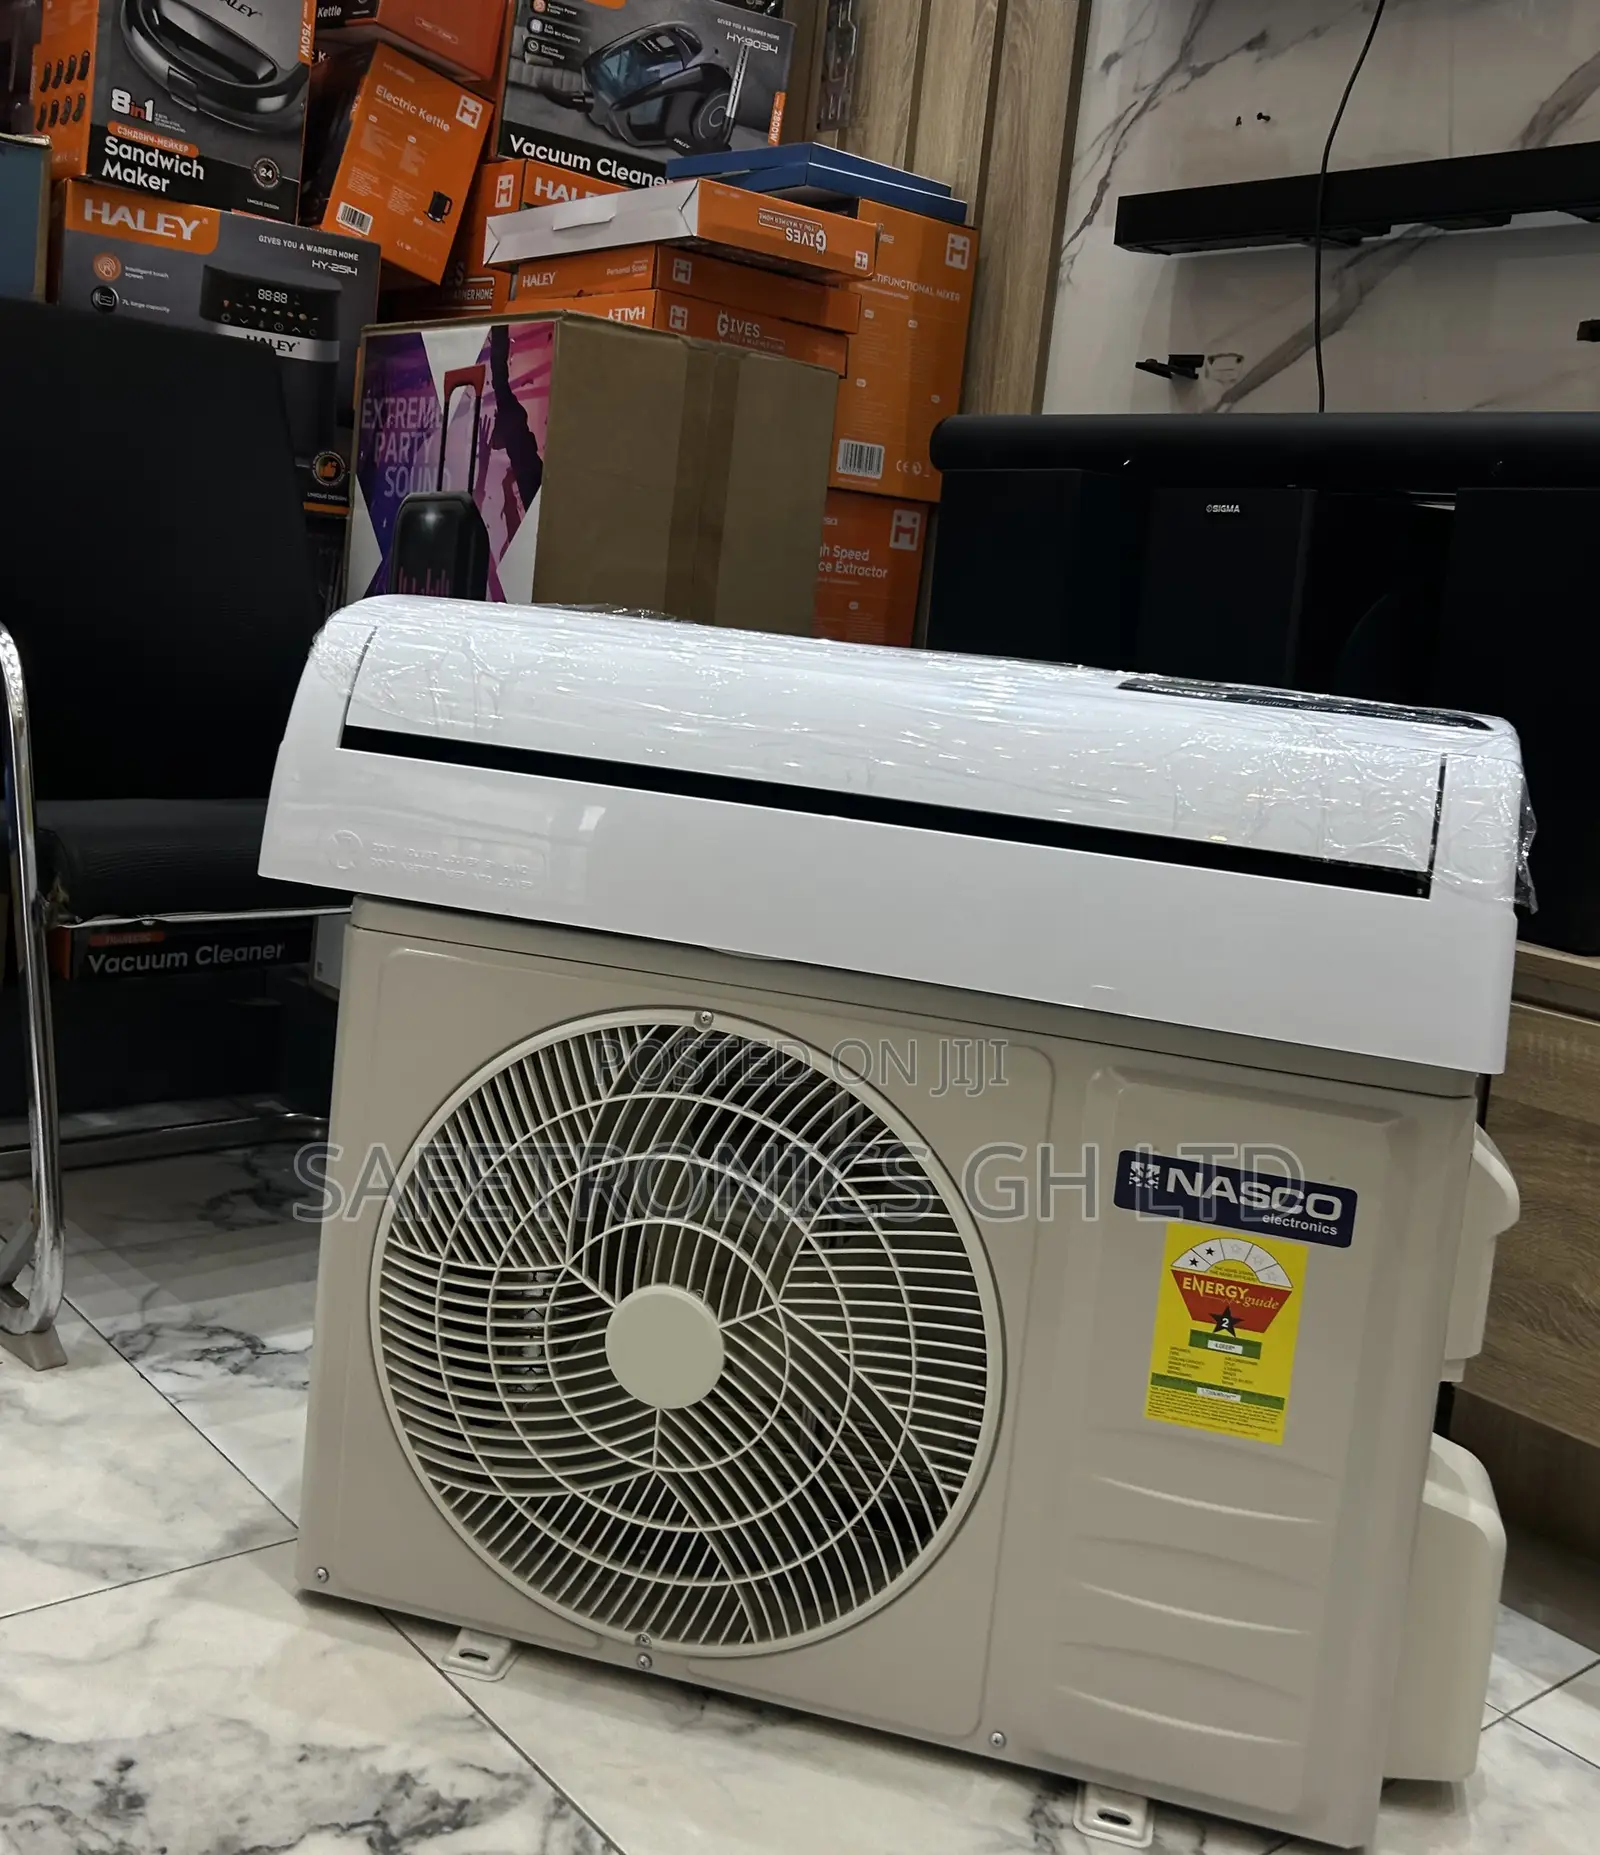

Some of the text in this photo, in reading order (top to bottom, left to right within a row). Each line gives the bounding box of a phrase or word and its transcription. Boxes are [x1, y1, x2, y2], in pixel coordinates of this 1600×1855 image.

[317, 5, 342, 18] Kettle
[300, 20, 312, 58] 750W
[726, 32, 779, 54] HY-9034
[375, 84, 417, 115] Electric
[418, 107, 451, 132] Kettle
[770, 110, 782, 142] 2800W
[104, 136, 205, 180] Sandwich
[510, 133, 590, 174] Vacuum
[102, 159, 170, 192] Maker
[259, 168, 272, 178] 24
[84, 198, 200, 240] HALEY
[759, 212, 774, 222] HOME
[774, 216, 798, 228] WARMER
[258, 234, 282, 246] GIVES
[282, 239, 298, 249] YOU
[306, 244, 338, 256] WARMER
[338, 250, 360, 262] HOME
[785, 227, 826, 254] GIVES
[522, 272, 556, 288] HALEY
[476, 288, 494, 300] HOME
[936, 288, 962, 304] MIXER
[146, 304, 170, 314] capacity
[608, 306, 646, 322] HALEY
[717, 309, 760, 338] GIVES
[374, 431, 434, 465] PARTY
[833, 544, 870, 562] Speed
[835, 560, 888, 579] Extractor
[88, 942, 285, 974] Vacuum Cleaner
[1166, 1167, 1342, 1221] NASCO
[1262, 1213, 1338, 1236] electronics
[1182, 1274, 1280, 1310] ENERGY guide
[1222, 1317, 1230, 1328] 2
